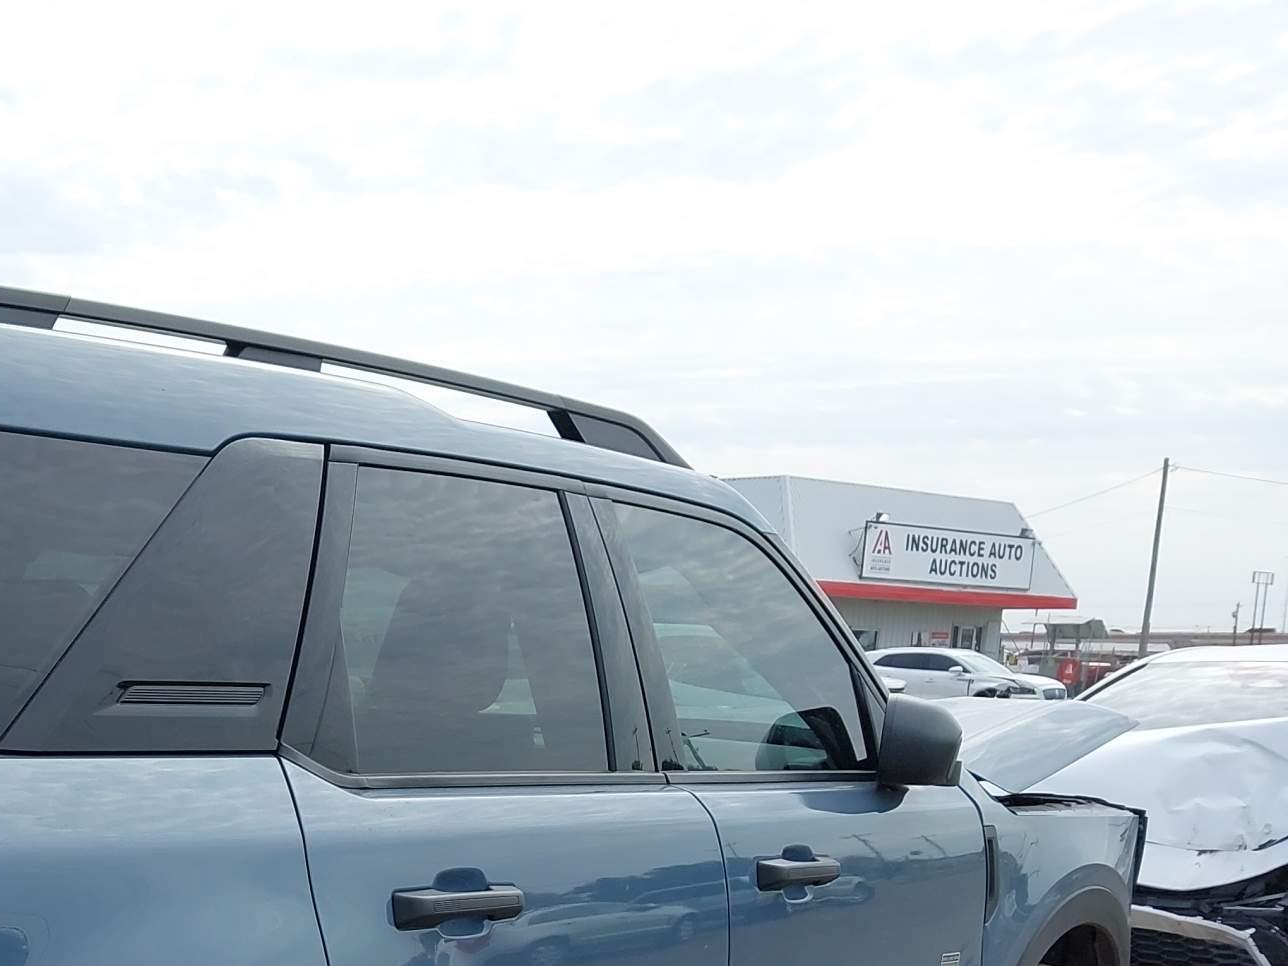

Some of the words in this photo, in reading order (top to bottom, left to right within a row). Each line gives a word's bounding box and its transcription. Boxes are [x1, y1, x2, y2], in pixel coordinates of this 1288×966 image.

[905, 533, 986, 558] INSURANCE
[988, 542, 1023, 561] AUTO
[929, 558, 998, 580] AUCTIONS
